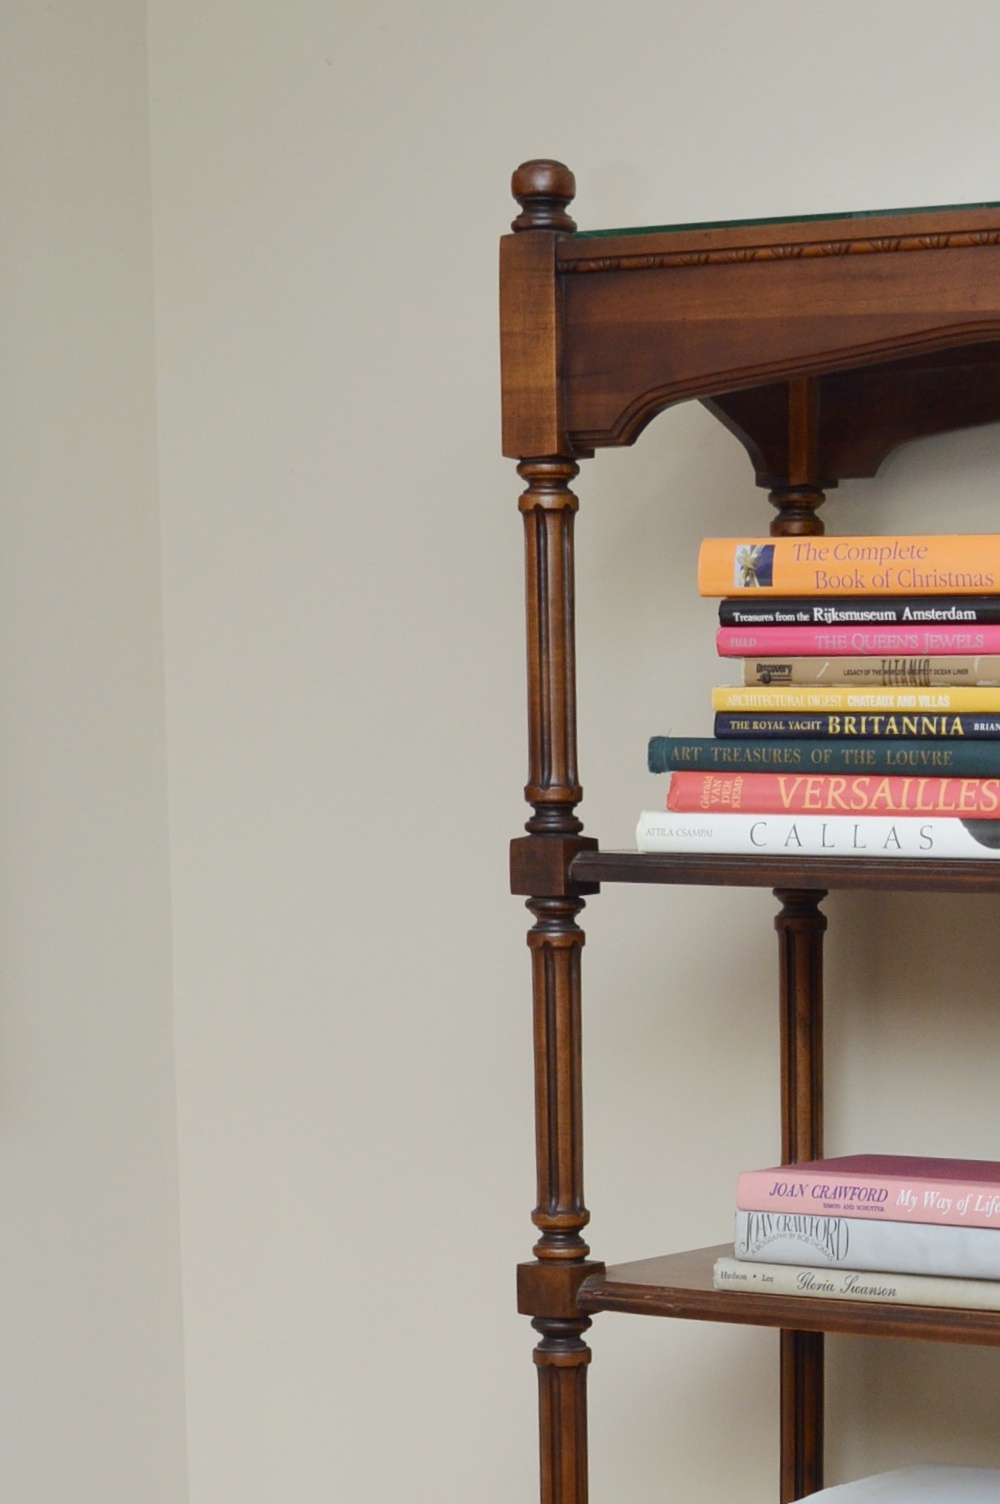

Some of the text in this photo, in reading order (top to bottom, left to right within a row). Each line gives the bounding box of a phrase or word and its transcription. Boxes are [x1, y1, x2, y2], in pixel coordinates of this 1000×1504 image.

[793, 541, 928, 566] The Complete
[815, 567, 994, 589] Book of Christmas
[733, 606, 976, 624] Treasures from the Rijksmuseum Amsterdam
[730, 638, 756, 647] FIELD
[815, 635, 846, 650] THE
[923, 633, 984, 653] JEWELS
[756, 663, 793, 674] Discovery
[881, 659, 930, 686] TITANIC
[933, 668, 951, 676] OCEAN
[727, 694, 950, 707] ARCHITECTURAL DIGEST CHATEAUX AND VILLAS
[730, 715, 965, 735] THE ROYAL YACHT BRITANNIA
[671, 747, 953, 766] ART TREASURES OF THE LOUVRE
[711, 780, 722, 803] VAN
[721, 780, 732, 804] DER
[732, 777, 744, 809] KEMP
[777, 777, 1000, 811] VERSAILLES
[645, 828, 713, 838] ATTILA CSAMPAI
[750, 822, 934, 850] CALLAS
[769, 1182, 1000, 1217] JOAN CRAWFORD My Way of Life
[856, 1204, 884, 1212] SCHUSTER
[739, 1213, 849, 1260] JOAN CRAWFORD
[755, 1233, 787, 1251] BIOGRAPHY
[762, 1274, 774, 1282] Lee
[796, 1271, 897, 1297] Gloria Swanson
